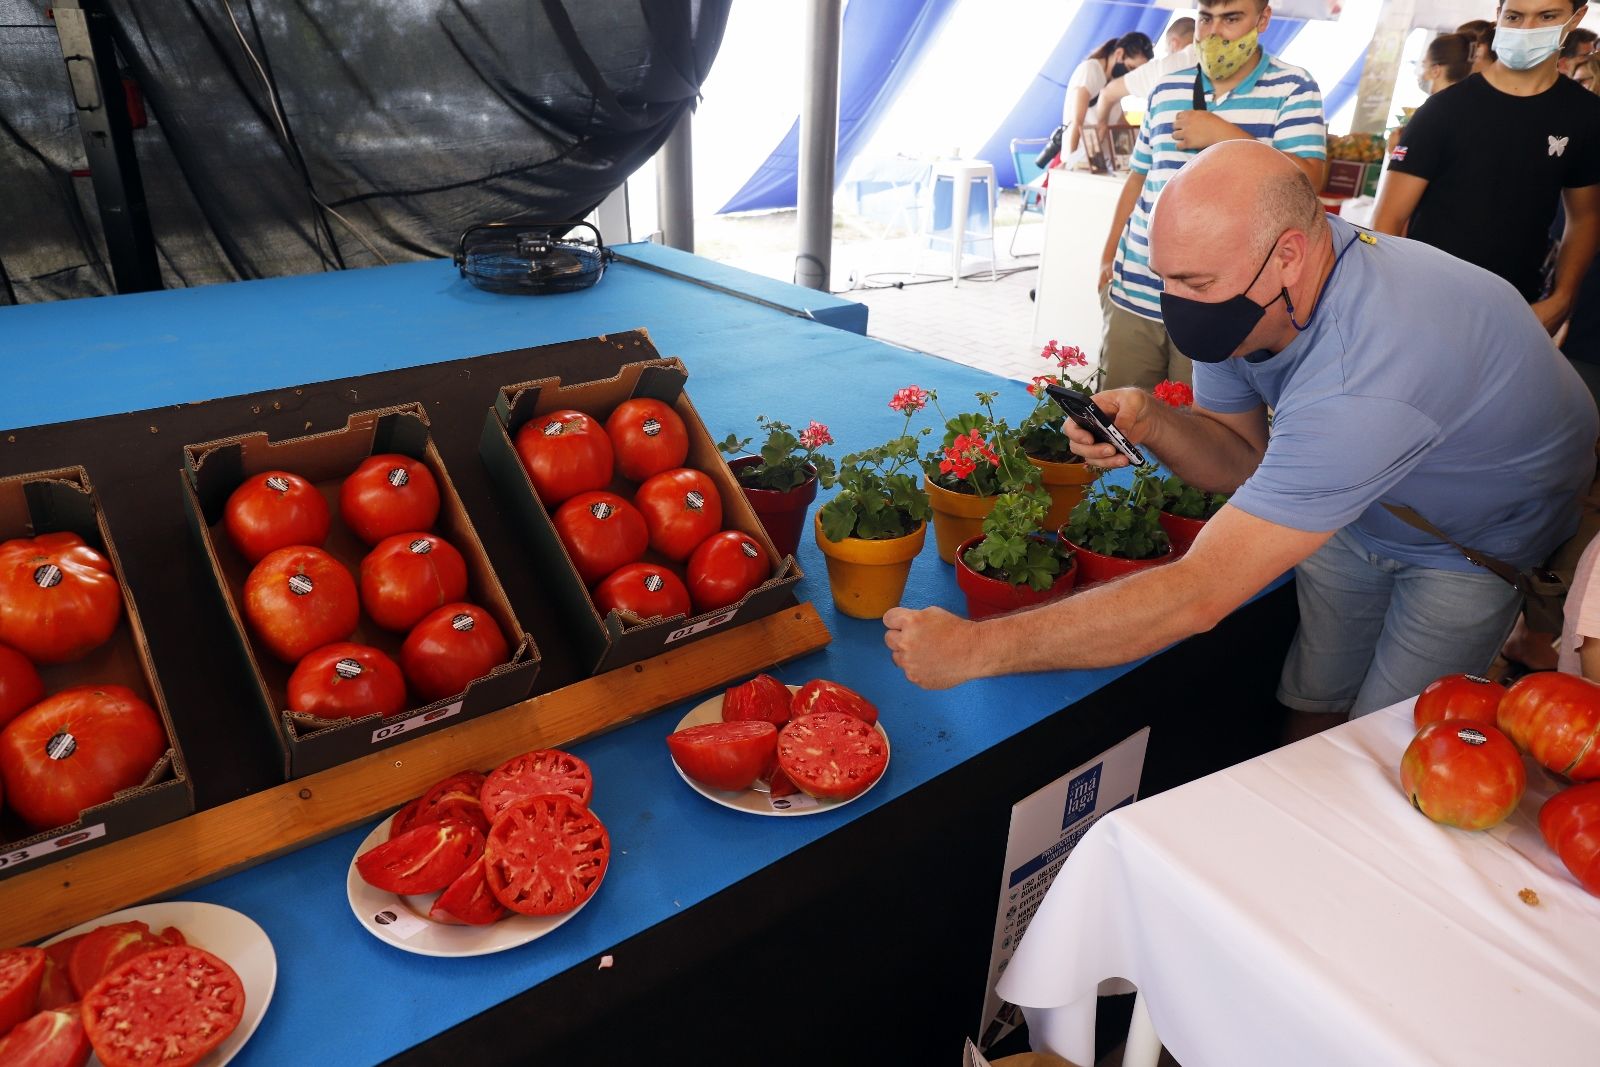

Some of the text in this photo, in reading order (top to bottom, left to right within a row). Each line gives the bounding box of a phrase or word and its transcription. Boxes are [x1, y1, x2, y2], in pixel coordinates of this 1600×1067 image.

[672, 626, 695, 640] 01
[376, 723, 405, 739] 02
[1074, 770, 1097, 800] má
[1067, 790, 1094, 814] laga
[1041, 832, 1076, 860] PROTOCOLO
[1020, 868, 1060, 899] DURANTE TOD
[1022, 878, 1035, 891] USO
[1017, 897, 1044, 919] MANTEN
[1019, 893, 1036, 909] EVITE
[1036, 889, 1043, 898] EL
